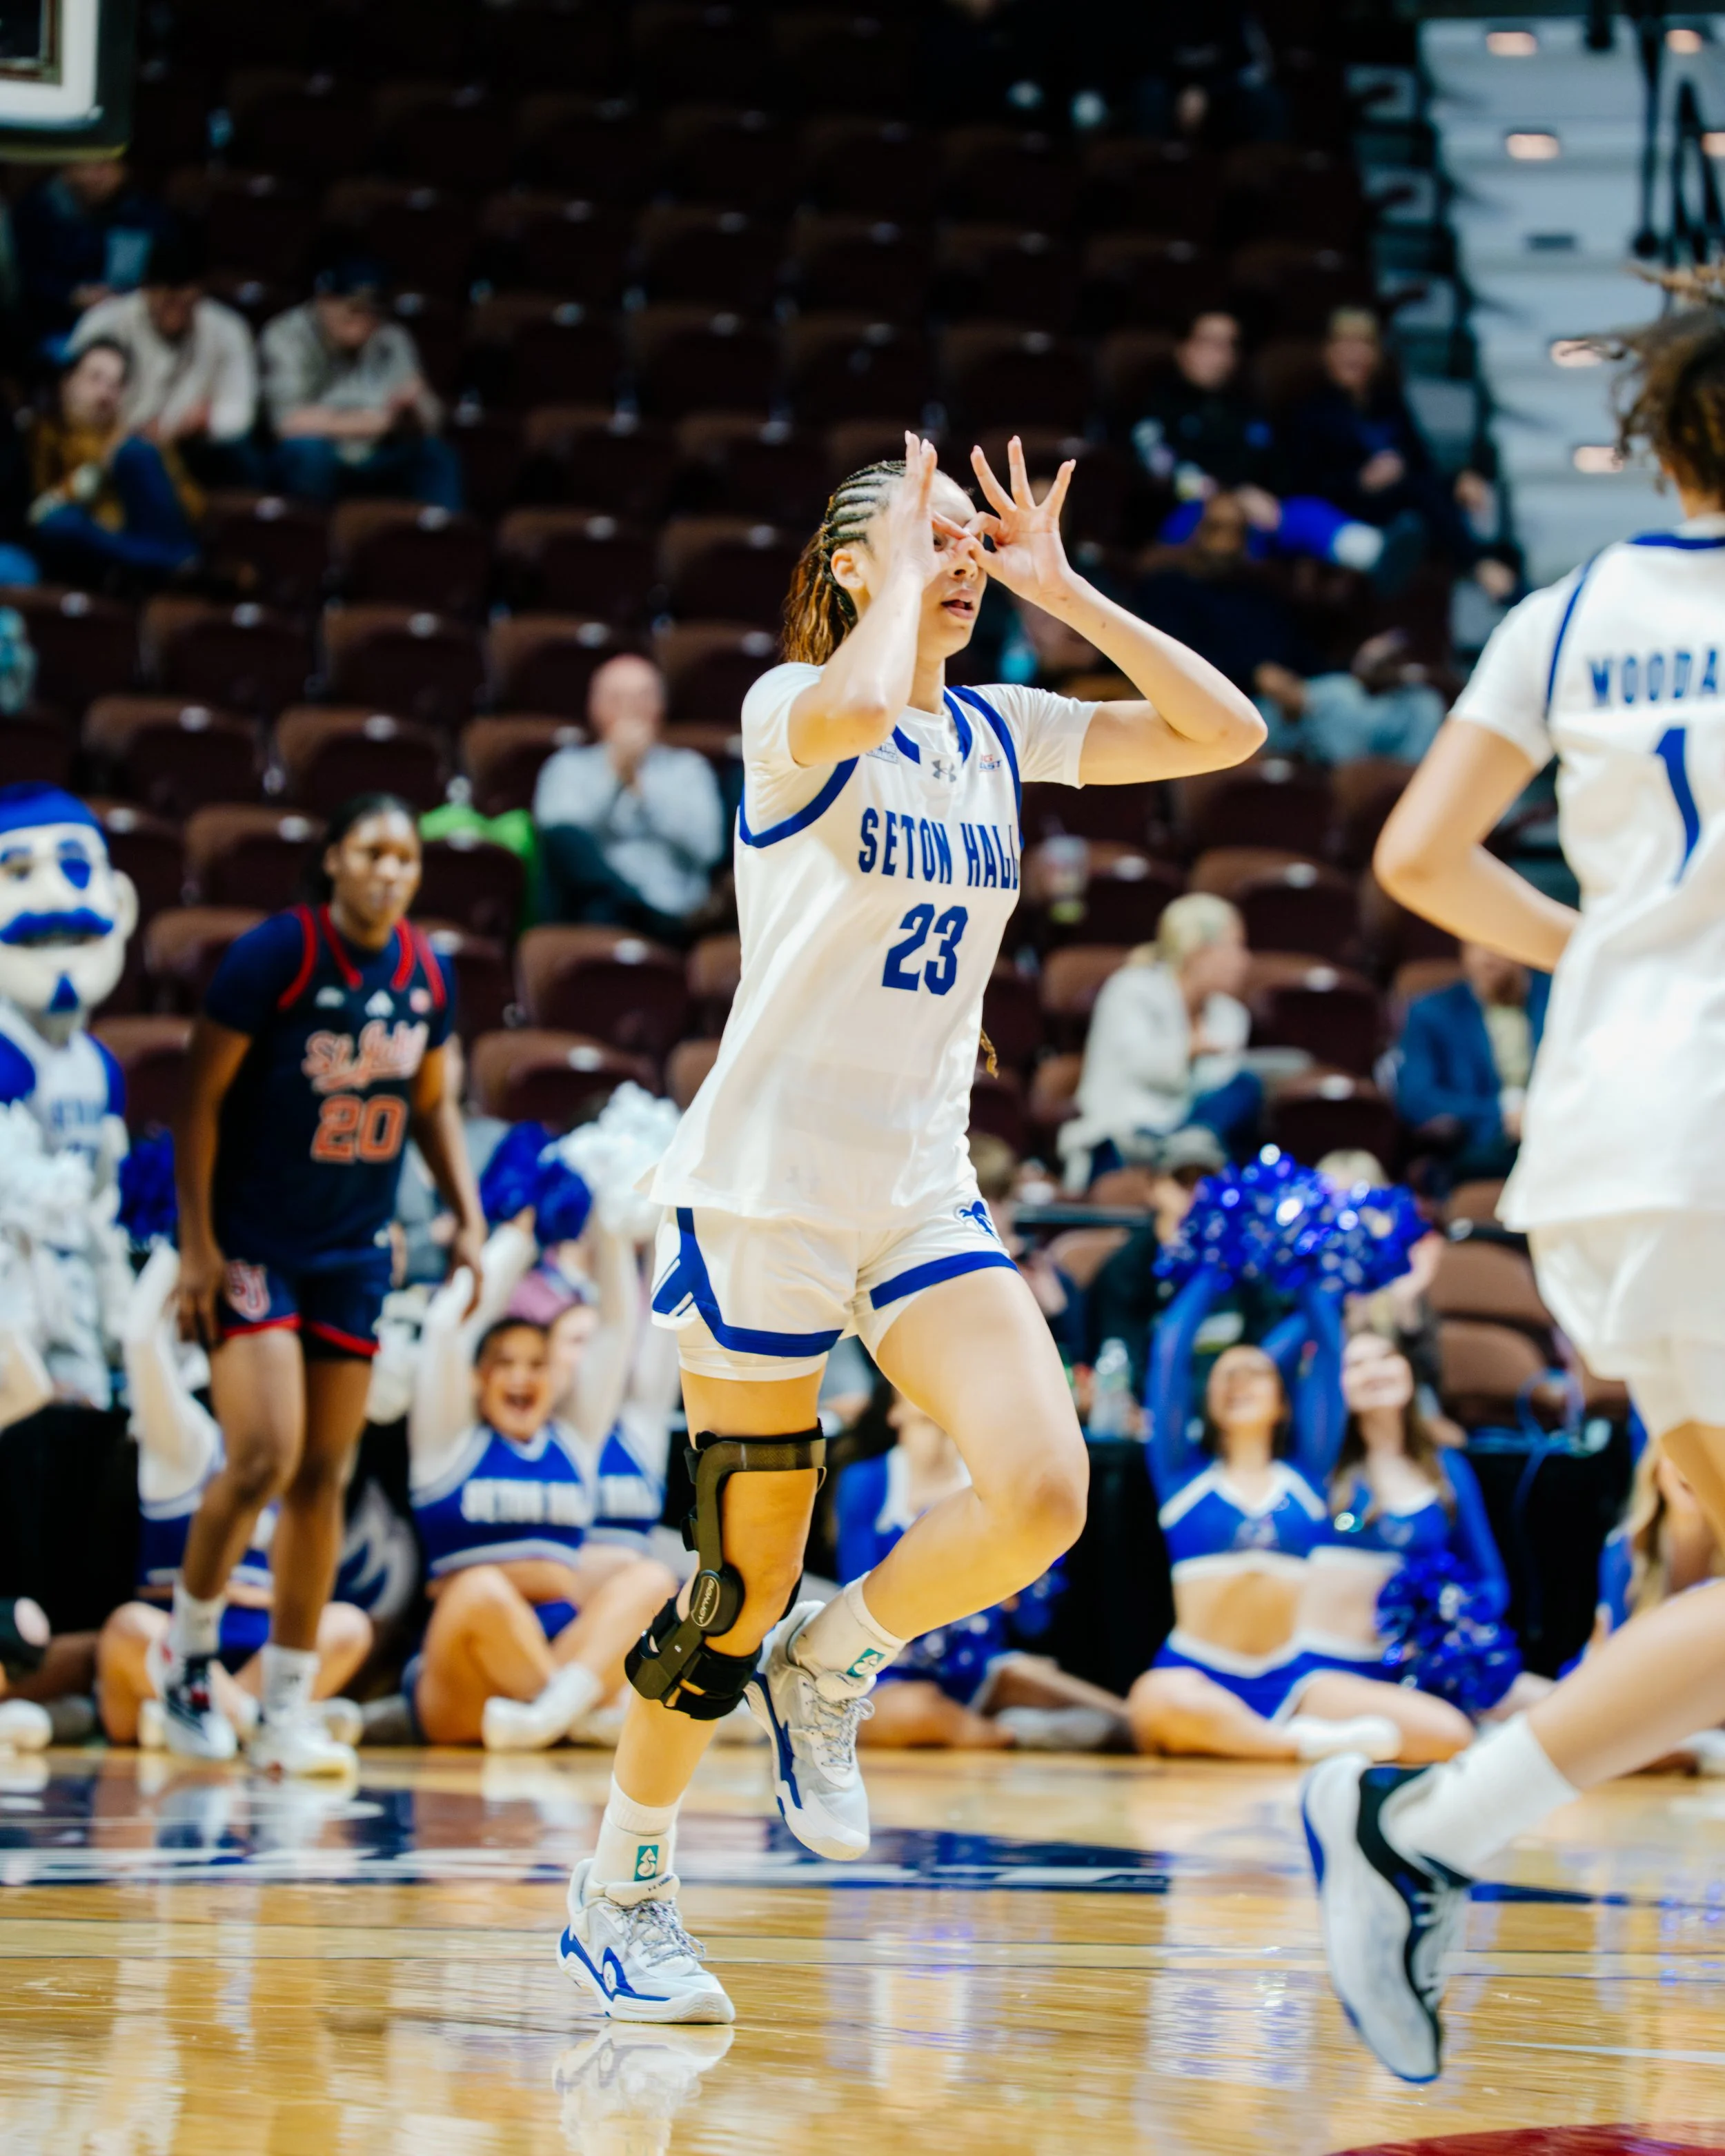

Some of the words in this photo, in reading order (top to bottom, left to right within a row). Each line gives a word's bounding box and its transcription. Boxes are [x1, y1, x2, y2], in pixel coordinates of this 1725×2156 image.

[1588, 649, 1718, 707] WOODA
[858, 807, 952, 885] SETON
[960, 822, 1019, 891] HALL
[1653, 727, 1701, 887] 1
[881, 903, 969, 996] 23
[311, 1094, 408, 1163] 20
